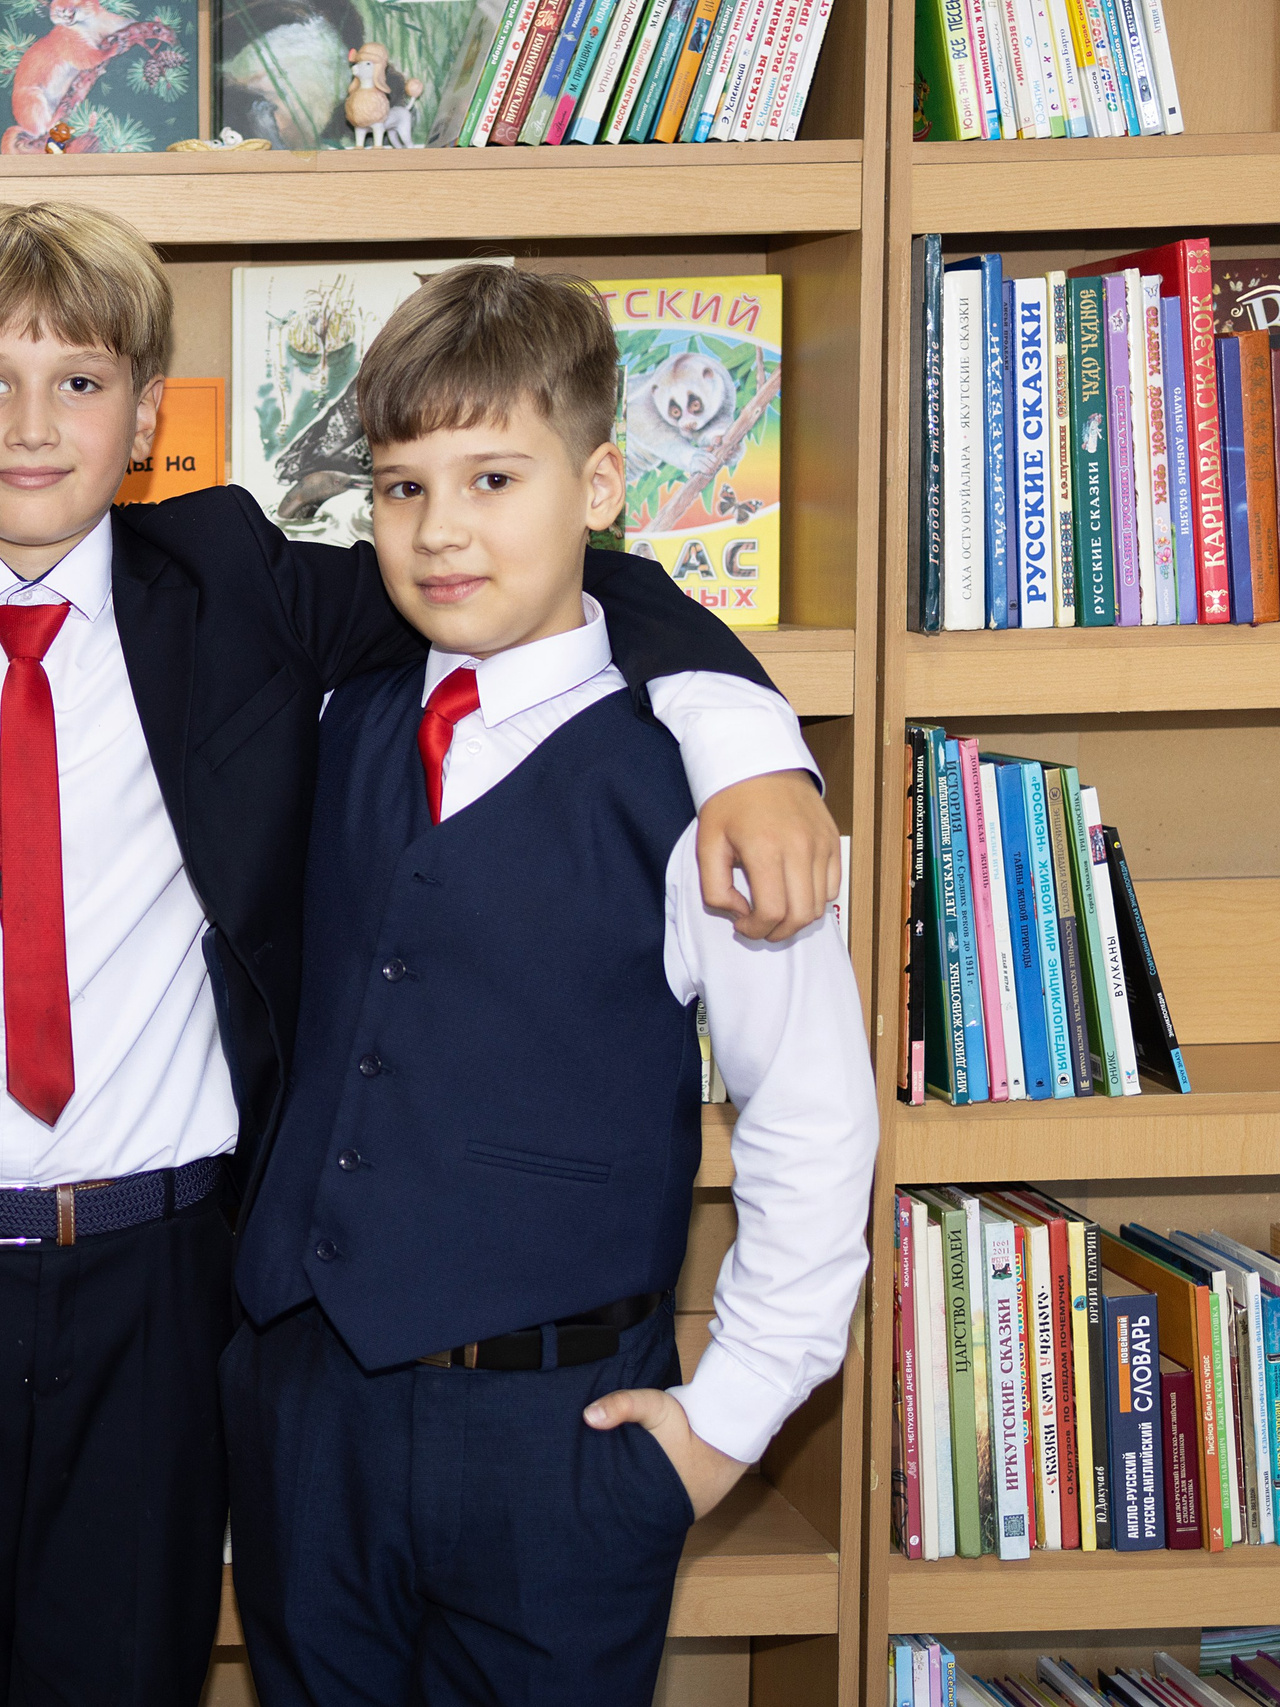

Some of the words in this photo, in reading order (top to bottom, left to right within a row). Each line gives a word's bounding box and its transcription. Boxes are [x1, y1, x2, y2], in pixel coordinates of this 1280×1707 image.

[572, 40, 595, 84] ПРИШВИН
[772, 6, 797, 74] рассказы
[1060, 28, 1070, 58] Барто
[505, 74, 527, 125] ВИТАЛИЙ
[522, 33, 547, 75] БИАНКИ
[614, 84, 634, 131] РАССКАЗЫ
[633, 37, 652, 78] ПРИРОДЕ
[730, 63, 746, 113] Успенский
[1063, 59, 1074, 85] Агния
[958, 297, 969, 352] СКАЗКИ
[1080, 288, 1098, 354] ЧУДНОЕ
[1146, 306, 1161, 377] СКАЗКИ
[1020, 301, 1043, 441] СКАЗКИ
[1080, 357, 1101, 403] ЧУДО
[1191, 294, 1217, 411] СКАЗОК
[960, 357, 971, 429] ЯКУТСКИЕ
[1148, 386, 1165, 457] ДОБРОЙ
[1115, 385, 1129, 468] ПИСАТЕЛЕЙ
[166, 456, 197, 473] на
[1154, 465, 1167, 505] ФЕИ
[1197, 416, 1225, 569] КАРНАВАЛ
[958, 445, 972, 560] ОСТУОРУЙАЛАРА
[1022, 451, 1047, 604] РУССКИЕ
[1088, 462, 1101, 532] СКАЗКИ
[1120, 470, 1133, 529] РУССКИХ
[961, 566, 972, 601] САХА
[1091, 537, 1106, 616] РУССКИЕ
[1122, 530, 1135, 587] СКАЗКИ
[916, 754, 924, 793] ГАЛЕОНА
[946, 760, 963, 834] ИСТОРИЯ
[916, 795, 925, 851] ПИРАТСКОГО
[938, 775, 952, 846] ЭНЦИКЛОПЕДИЯ
[970, 754, 985, 844] ДОИСТОРИЧЕСКАЯ
[979, 852, 990, 889] ЖИЗНЬ
[1030, 776, 1046, 853] «РОСМЭН»
[916, 852, 924, 881] ТАЙНА
[1012, 851, 1026, 885] ТАЙНЫ
[1052, 807, 1067, 878] ЭНЦИКЛОПЕДИЯ
[942, 852, 957, 918] ДЕТСКАЯ
[1016, 888, 1030, 922] ЖИВОЙ
[1038, 860, 1053, 916] ЖИВОЙ
[1058, 879, 1072, 914] АЗЕРОТА
[1018, 924, 1032, 969] ПРИРОДЫ
[1042, 920, 1056, 952] МИР
[1106, 936, 1124, 998] ВУЛКАНЫ
[949, 962, 962, 1029] ЖИВОТНЫХ
[1048, 958, 1068, 1070] ЭНЦИКЛОПЕДИЯ
[953, 1029, 965, 1068] ДИКИХ
[1106, 1050, 1119, 1085] ОНИКС
[955, 1069, 968, 1094] МИР
[948, 1229, 966, 1291] ЛЮДЕЙ
[1084, 1230, 1099, 1283] ГАГАРИН
[954, 1296, 972, 1374] ЦАРСТВО
[996, 1298, 1014, 1374] СКАЗКИ
[1057, 1274, 1069, 1350] ПОЧЕМУЧКИ
[1087, 1286, 1100, 1324] ЮРИЙ
[1060, 1352, 1070, 1407] СЛЕДАМ
[1130, 1315, 1154, 1414] СЛОВАРЬ
[1001, 1379, 1020, 1492] ИРКУТСКИЕ
[1064, 1408, 1071, 1423] ПО
[1139, 1422, 1157, 1538] РУССКО-АНГЛИЙСКИЙ
[1178, 1432, 1187, 1479] ШКОЛЬНИКОВ
[1122, 1452, 1140, 1540] АНГЛО-РУССКИЙ
[1181, 1480, 1189, 1494] ДЛЯ
[1181, 1494, 1190, 1524] СЛОВАРЬ
[1186, 1478, 1195, 1524] ГРАММАТИКА
